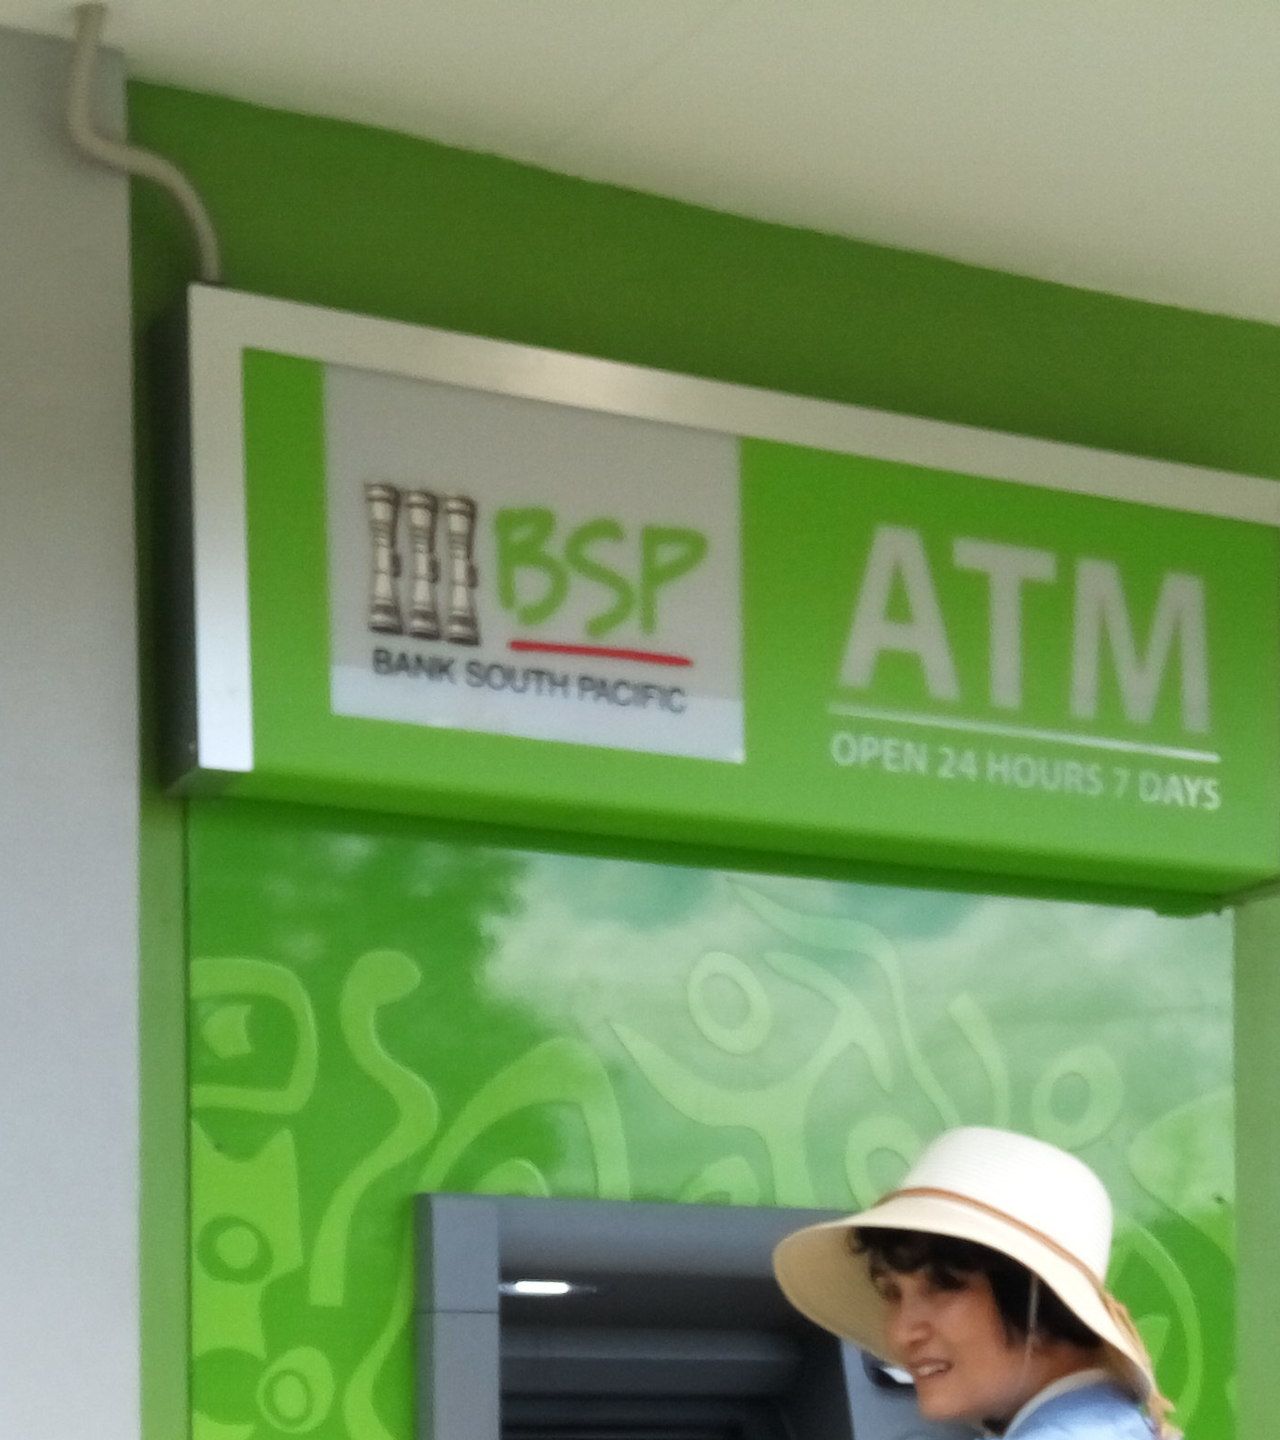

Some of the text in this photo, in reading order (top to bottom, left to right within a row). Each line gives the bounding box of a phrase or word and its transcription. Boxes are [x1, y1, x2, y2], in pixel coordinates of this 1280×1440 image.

[495, 506, 707, 637] BSP
[372, 648, 687, 714] BANK SOUTH PACIFIC
[839, 523, 1211, 734] ATM
[830, 731, 1220, 810] OPEN 24 HOURS 7 DAYS
